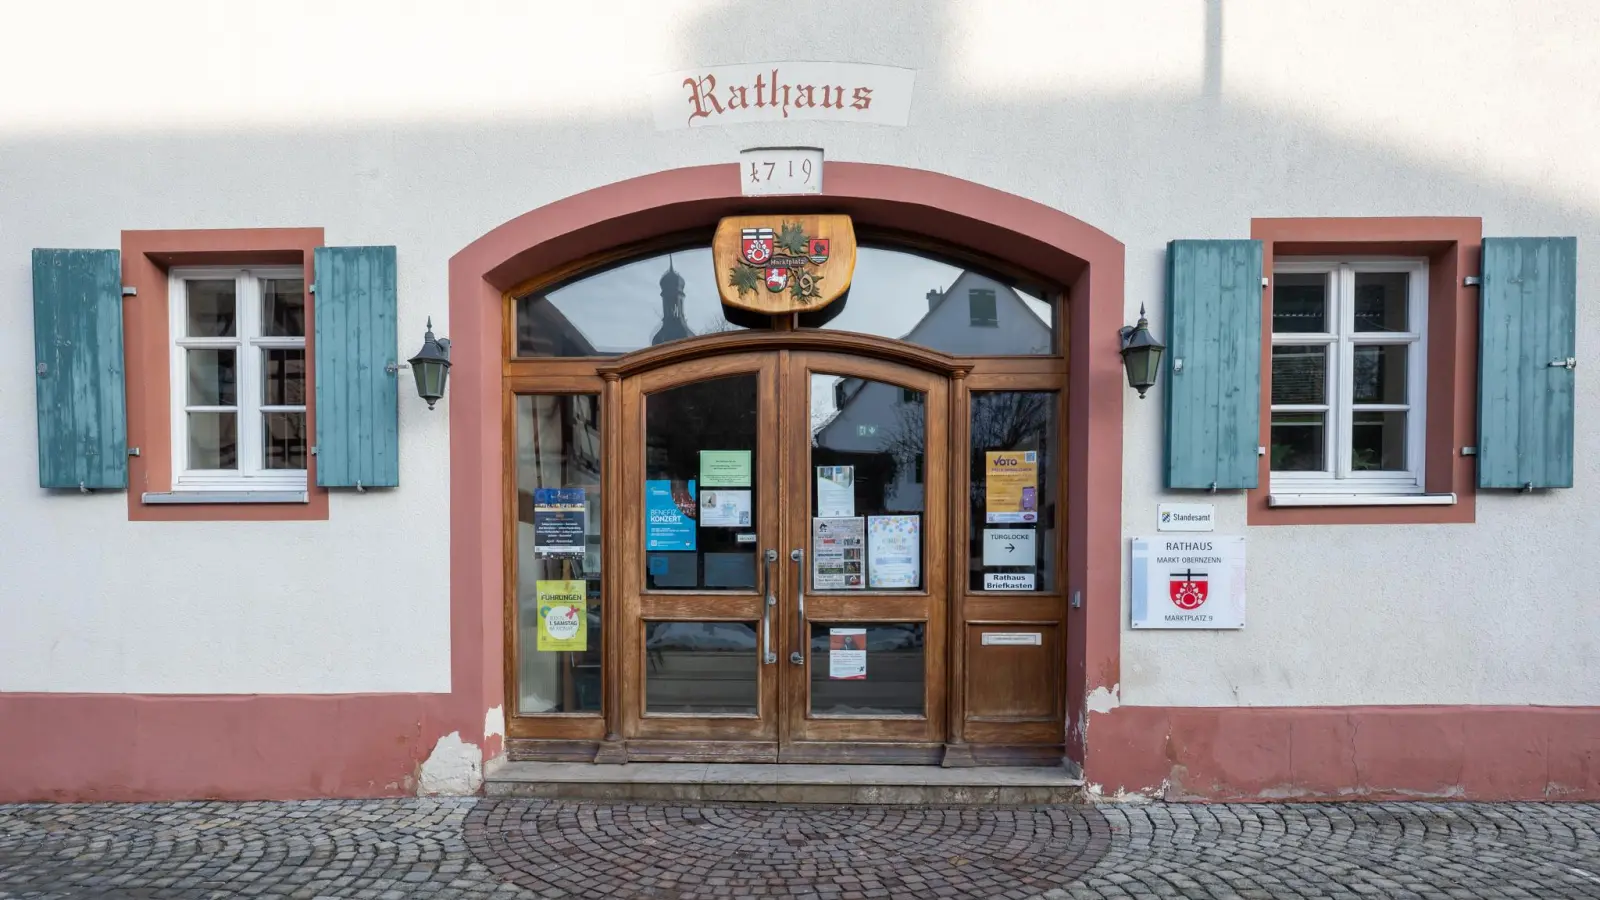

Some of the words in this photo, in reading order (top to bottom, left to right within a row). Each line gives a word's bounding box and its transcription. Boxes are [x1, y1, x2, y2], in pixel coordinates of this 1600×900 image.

[683, 68, 874, 127] Rathaus
[750, 158, 812, 184] 1719
[770, 257, 806, 266] Marktplatz
[800, 276, 814, 296] 9
[650, 515, 682, 523] KONZERT
[1173, 513, 1211, 521] Standesamt
[1166, 542, 1213, 551] RATHAUS
[1156, 556, 1180, 564] MARKT
[1181, 556, 1222, 564] OBERNZENN
